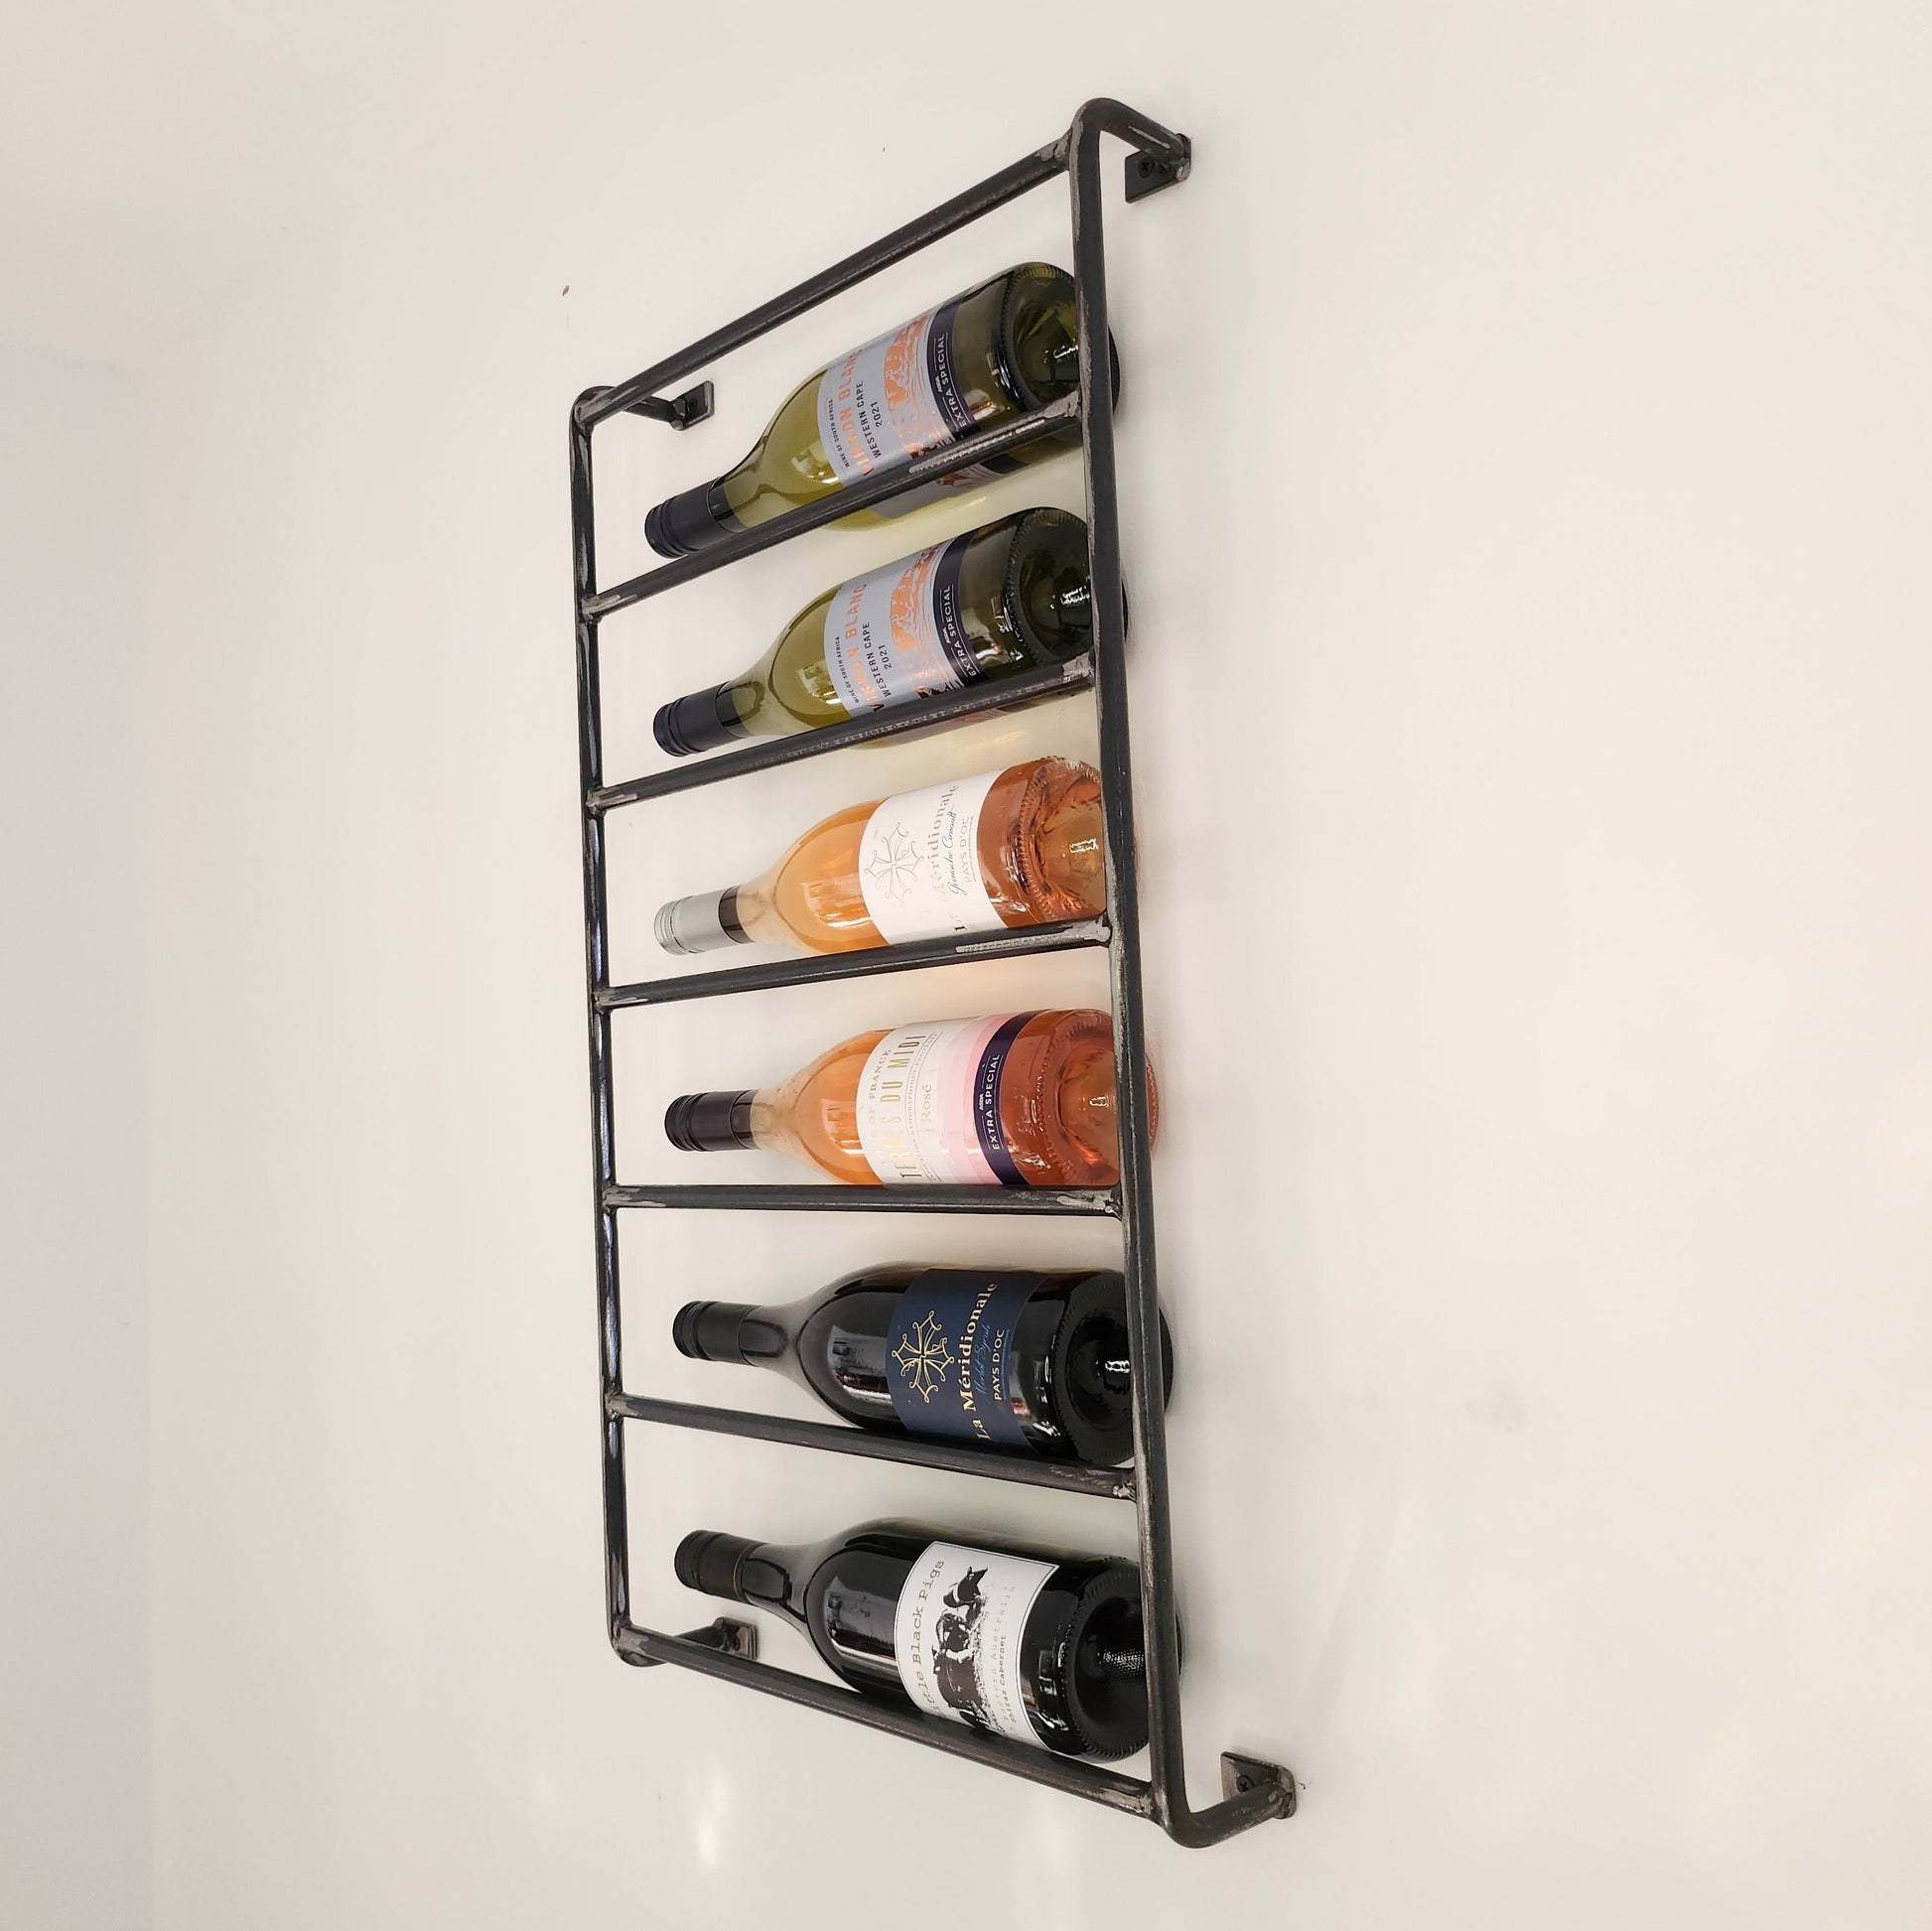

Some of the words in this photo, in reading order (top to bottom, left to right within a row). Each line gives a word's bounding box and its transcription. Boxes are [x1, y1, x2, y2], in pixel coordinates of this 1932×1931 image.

[937, 334, 949, 387] SPECIAL
[856, 381, 866, 407] CAPE
[945, 387, 968, 428] EXTRA
[830, 421, 839, 443] SOUTH
[871, 401, 884, 427] 2021
[858, 410, 882, 459] WESTERN
[846, 583, 868, 641] BLANC
[943, 586, 957, 637] SPECIAL
[862, 621, 872, 649] CAPE
[839, 659, 848, 679] SOUTH
[866, 651, 892, 698] WESTERN
[878, 644, 892, 670] 2021
[953, 641, 977, 677] EXTRA
[959, 817, 969, 848] D'OC
[959, 852, 972, 884] PAYS
[888, 1034, 925, 1069] MIDI
[869, 1048, 892, 1099] FRANCE
[880, 1080, 903, 1103] DU
[985, 1054, 1001, 1105] SPECIAL
[920, 1084, 932, 1123] Rosé
[880, 1116, 921, 1179] TERS
[985, 1110, 1000, 1150] EXTRA
[957, 1283, 998, 1412] Méridionale
[993, 1328, 1005, 1363] D'OC
[993, 1366, 1003, 1401] PAYS
[972, 1418, 991, 1440] La
[911, 1605, 923, 1664] Black
[918, 1560, 945, 1601] Pigs
[997, 1633, 1007, 1686] Cabernet
